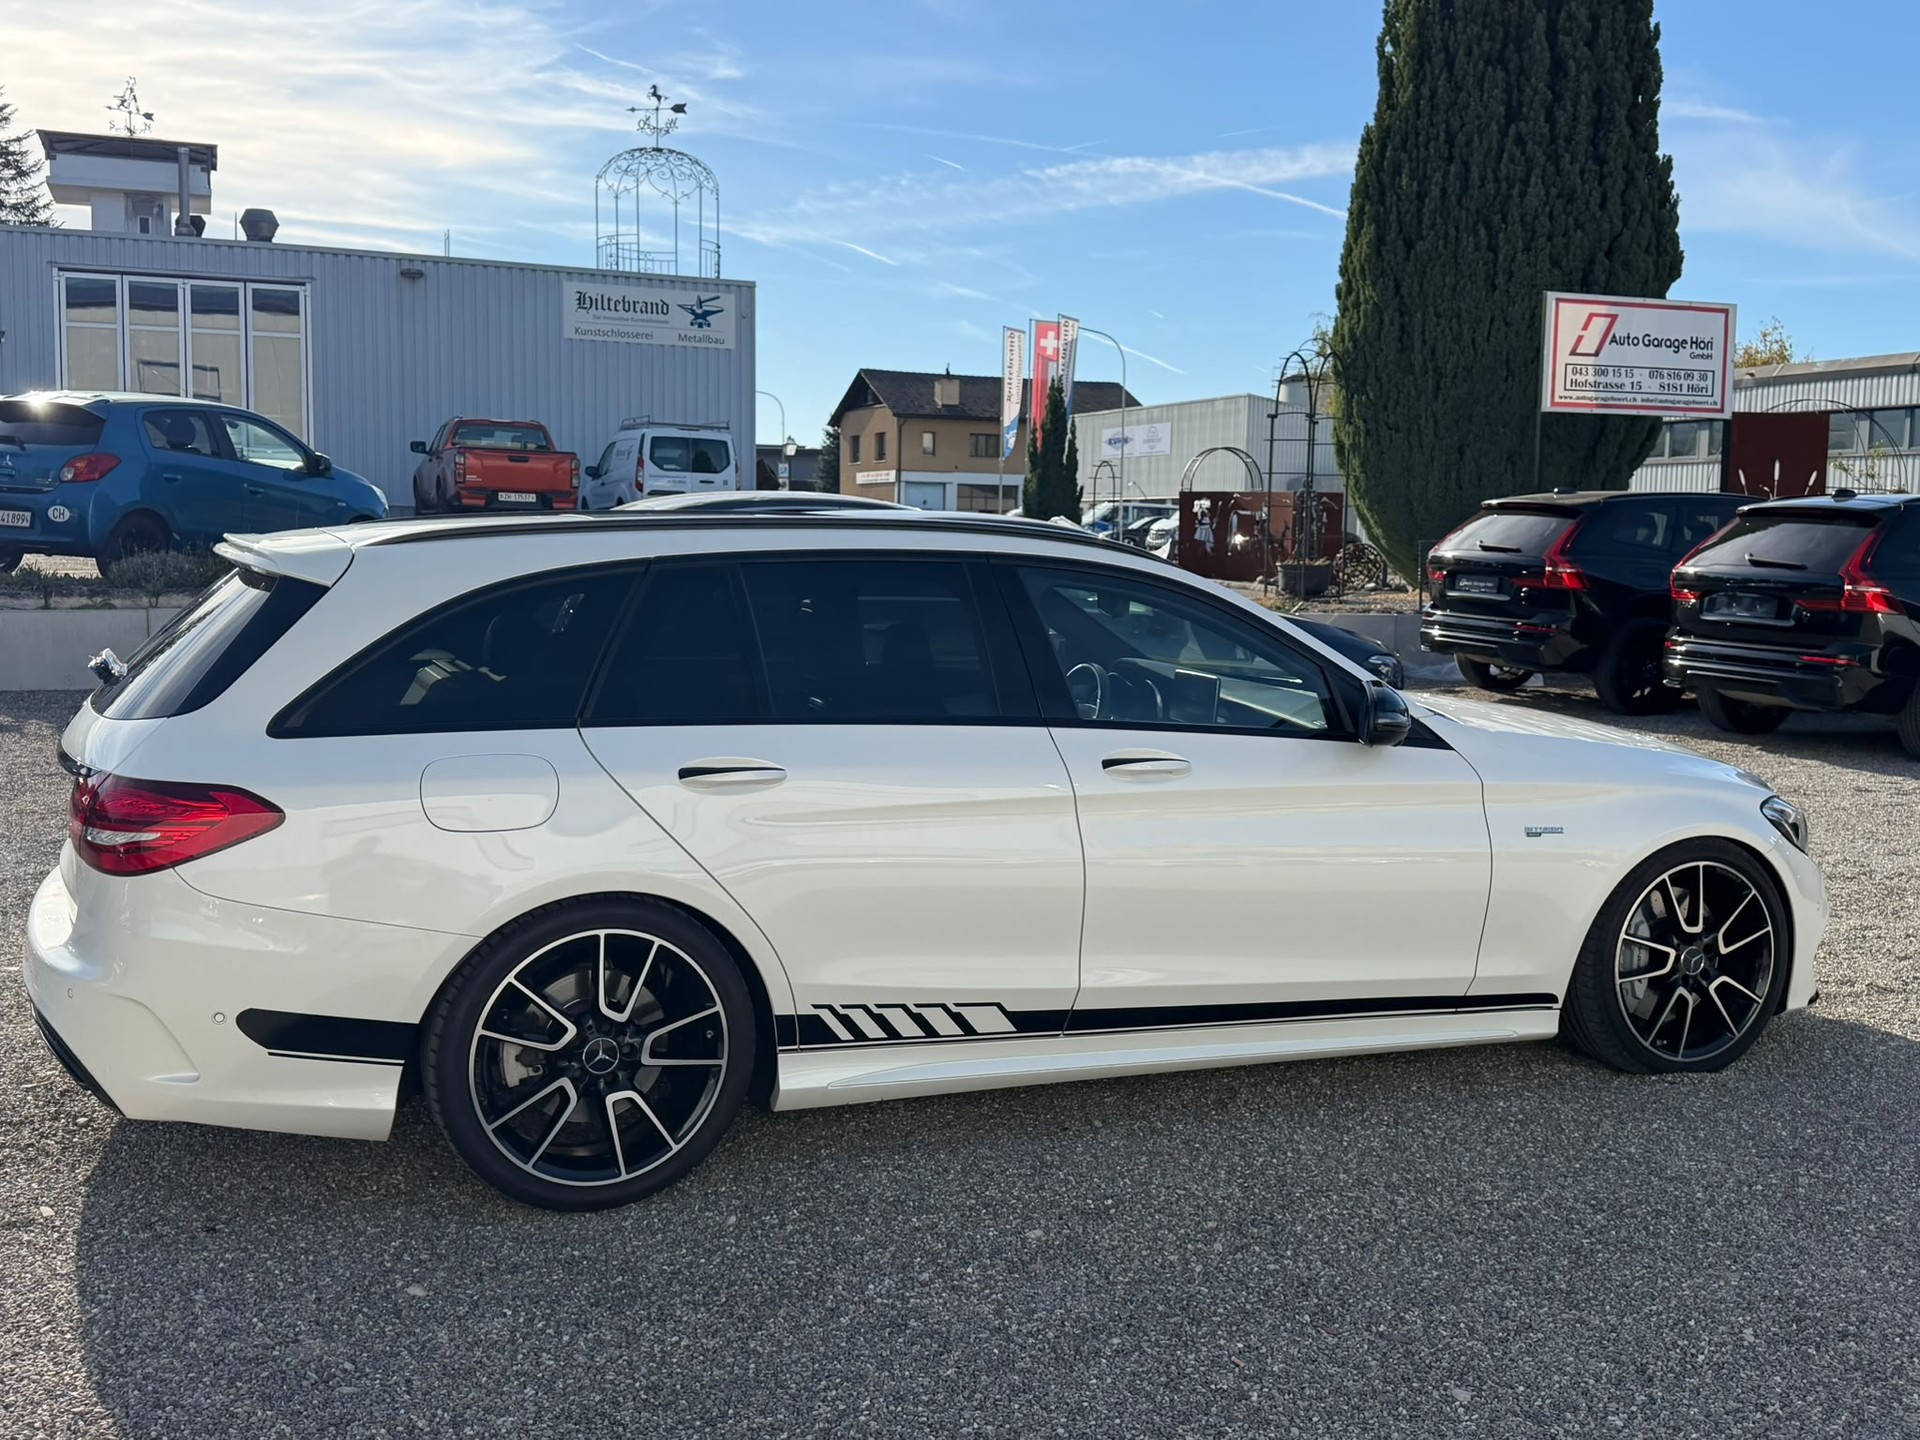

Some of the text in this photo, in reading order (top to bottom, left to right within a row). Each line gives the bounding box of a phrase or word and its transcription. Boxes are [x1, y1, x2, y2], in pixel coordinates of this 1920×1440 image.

[575, 290, 670, 315] Hiltebrand
[574, 326, 725, 345] Kunstschlosserei Metallbau
[1608, 332, 1714, 354] Auto Garage Höri
[1689, 352, 1713, 360] GmbH
[1571, 367, 1708, 382] 043 300 15 15 076 816 09 30
[1570, 378, 1708, 393] Hofstrasse 15 8181 Höri
[1, 512, 25, 524] 41899
[52, 508, 65, 520] CH
